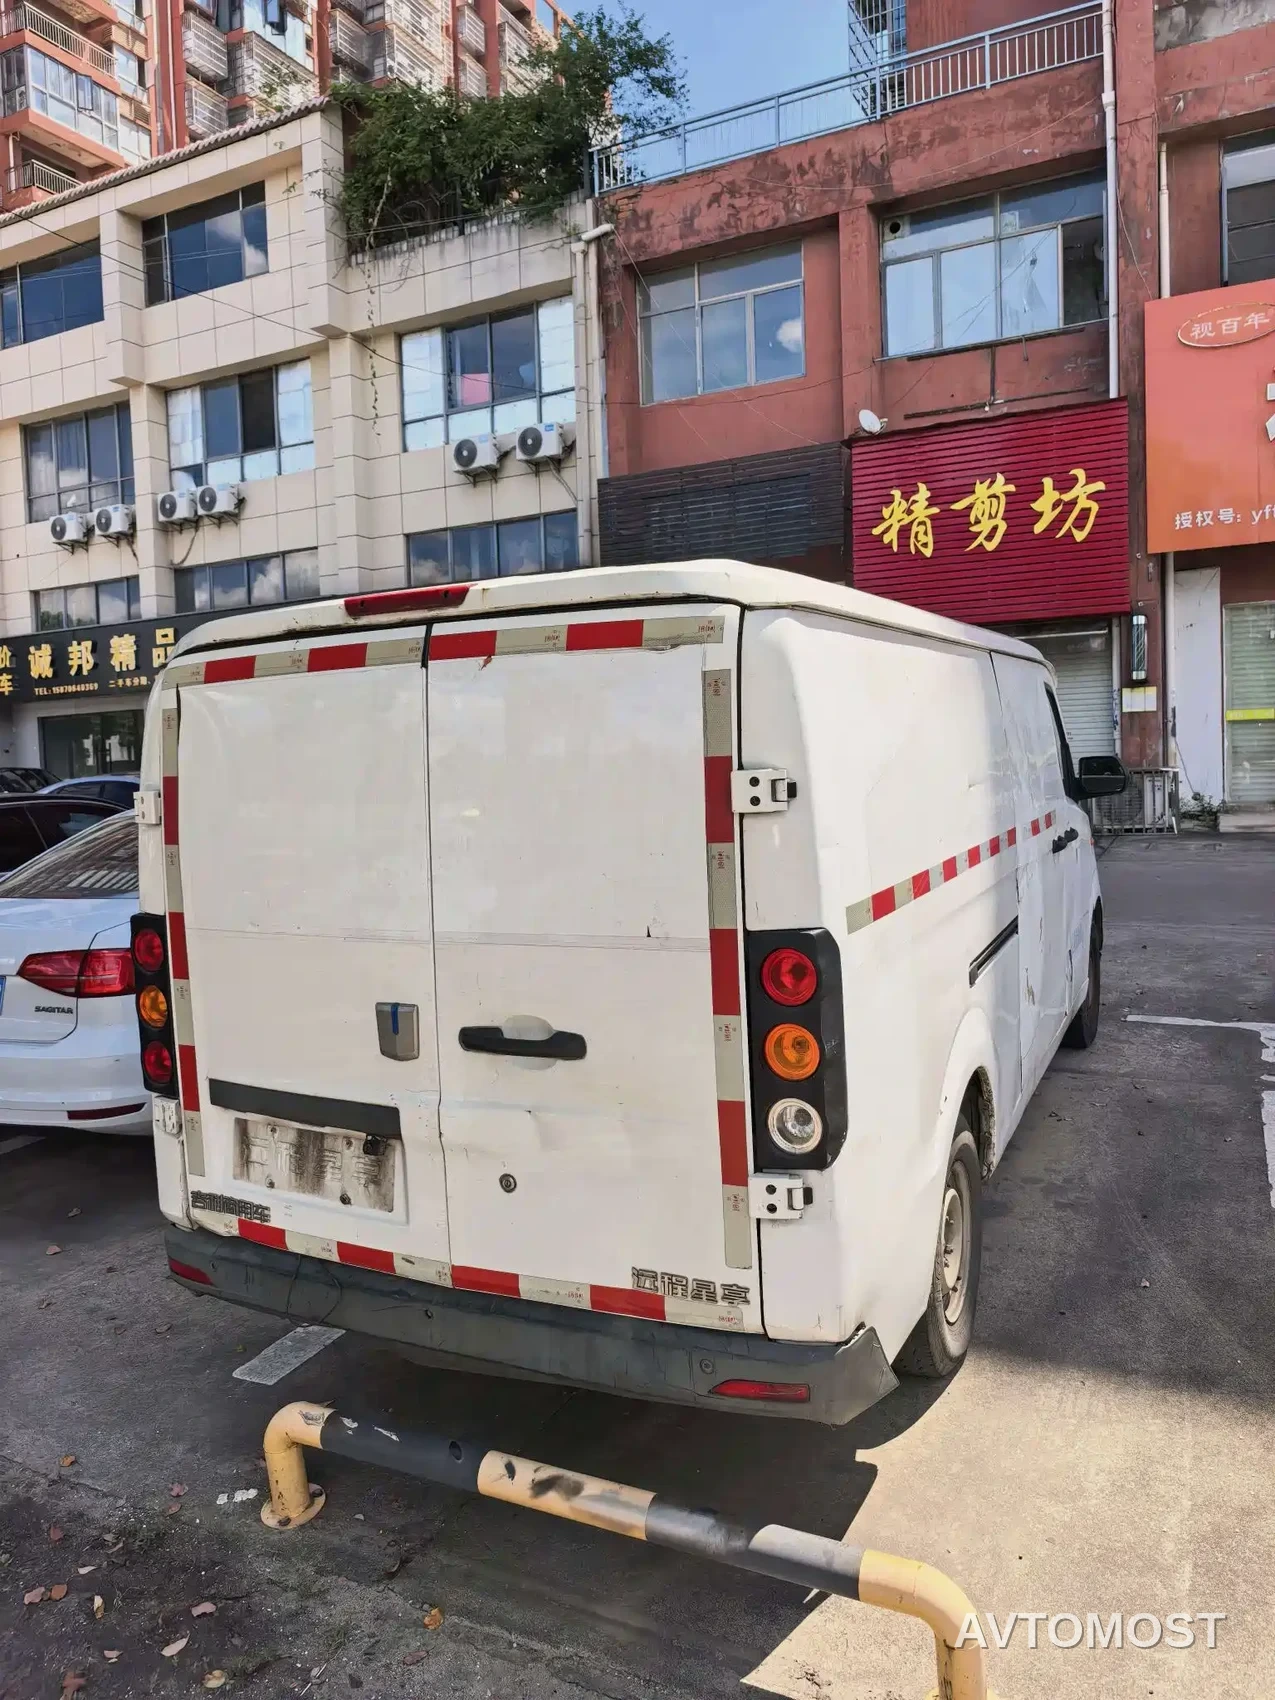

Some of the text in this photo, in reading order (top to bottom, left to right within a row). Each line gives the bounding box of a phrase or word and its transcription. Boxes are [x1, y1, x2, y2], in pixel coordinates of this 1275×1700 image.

[1190, 312, 1270, 339] 视百年
[871, 468, 1106, 558] 精剪坊
[28, 628, 175, 679] 诚邦精品
[34, 1005, 74, 1014] SAGITAR
[631, 1266, 750, 1306] 远程星享
